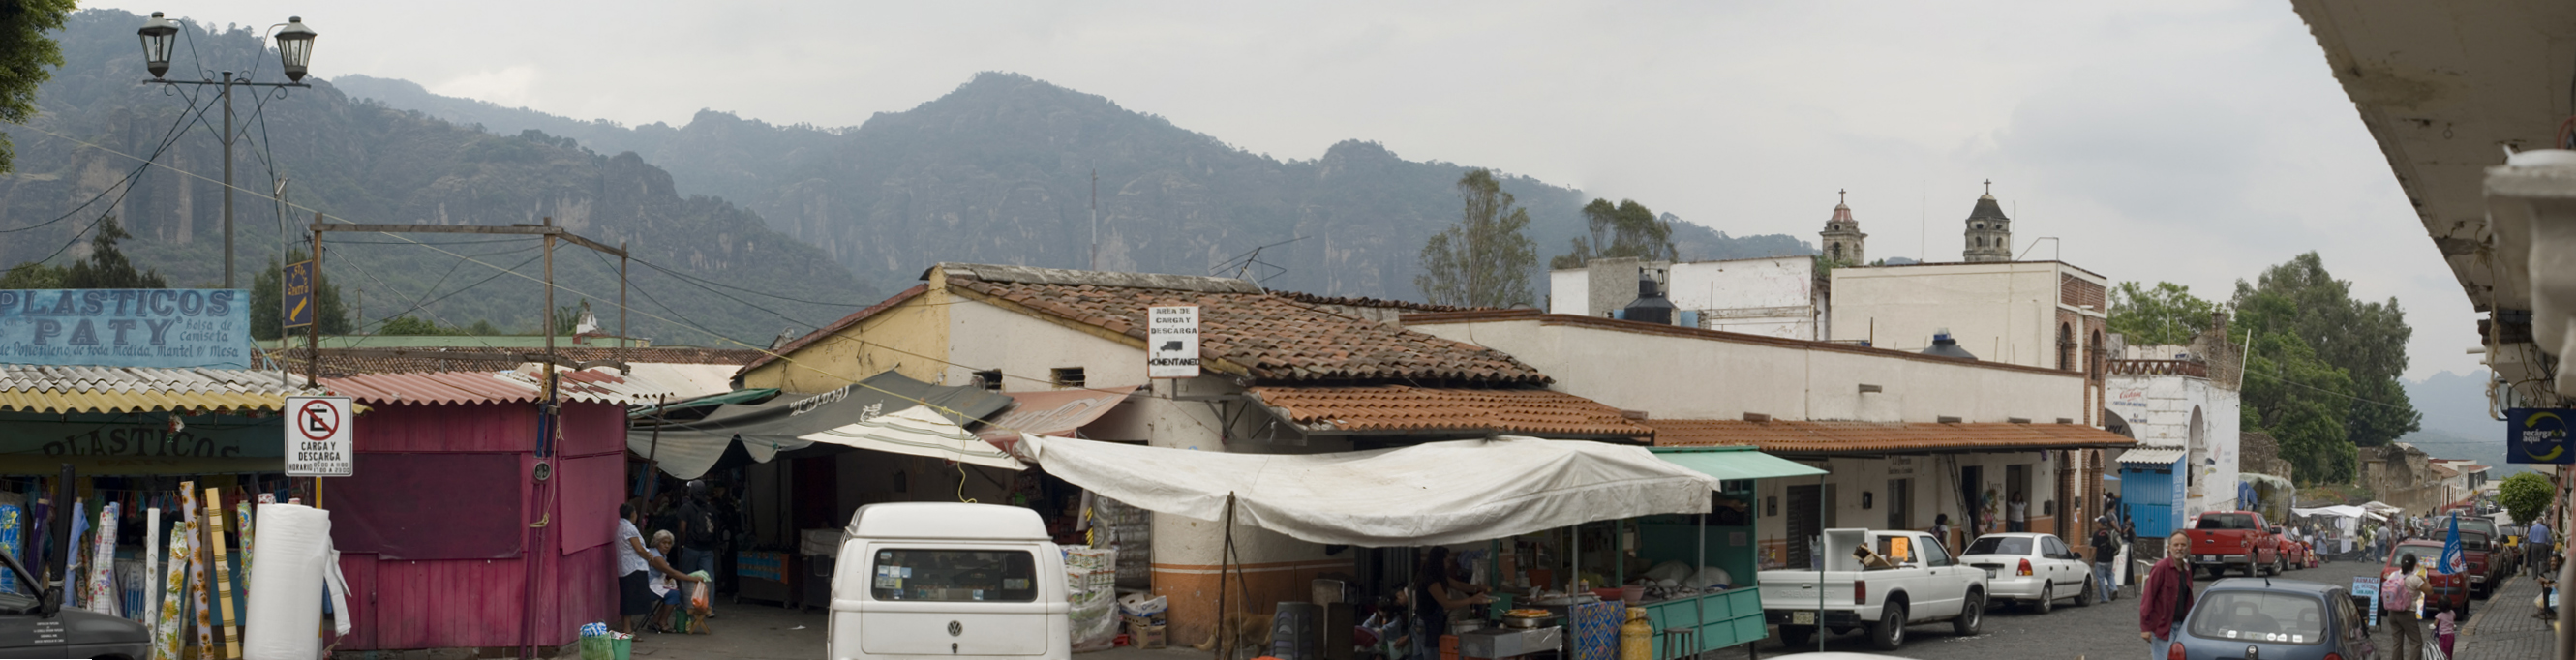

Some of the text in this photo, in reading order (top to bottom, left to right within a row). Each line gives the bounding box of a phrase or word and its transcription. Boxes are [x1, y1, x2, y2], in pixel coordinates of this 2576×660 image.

[0, 289, 234, 317] PLASTICOS
[186, 318, 232, 331] Bolsa de
[180, 330, 229, 343] Camiseta
[73, 344, 84, 356] de
[156, 345, 194, 357] Mantel
[209, 346, 239, 357] Mesa
[1149, 357, 1200, 366] MOMENTANEO
[301, 441, 336, 451] CARGA Y
[298, 452, 341, 462] DESCARGA
[288, 463, 313, 471] HORARIO
